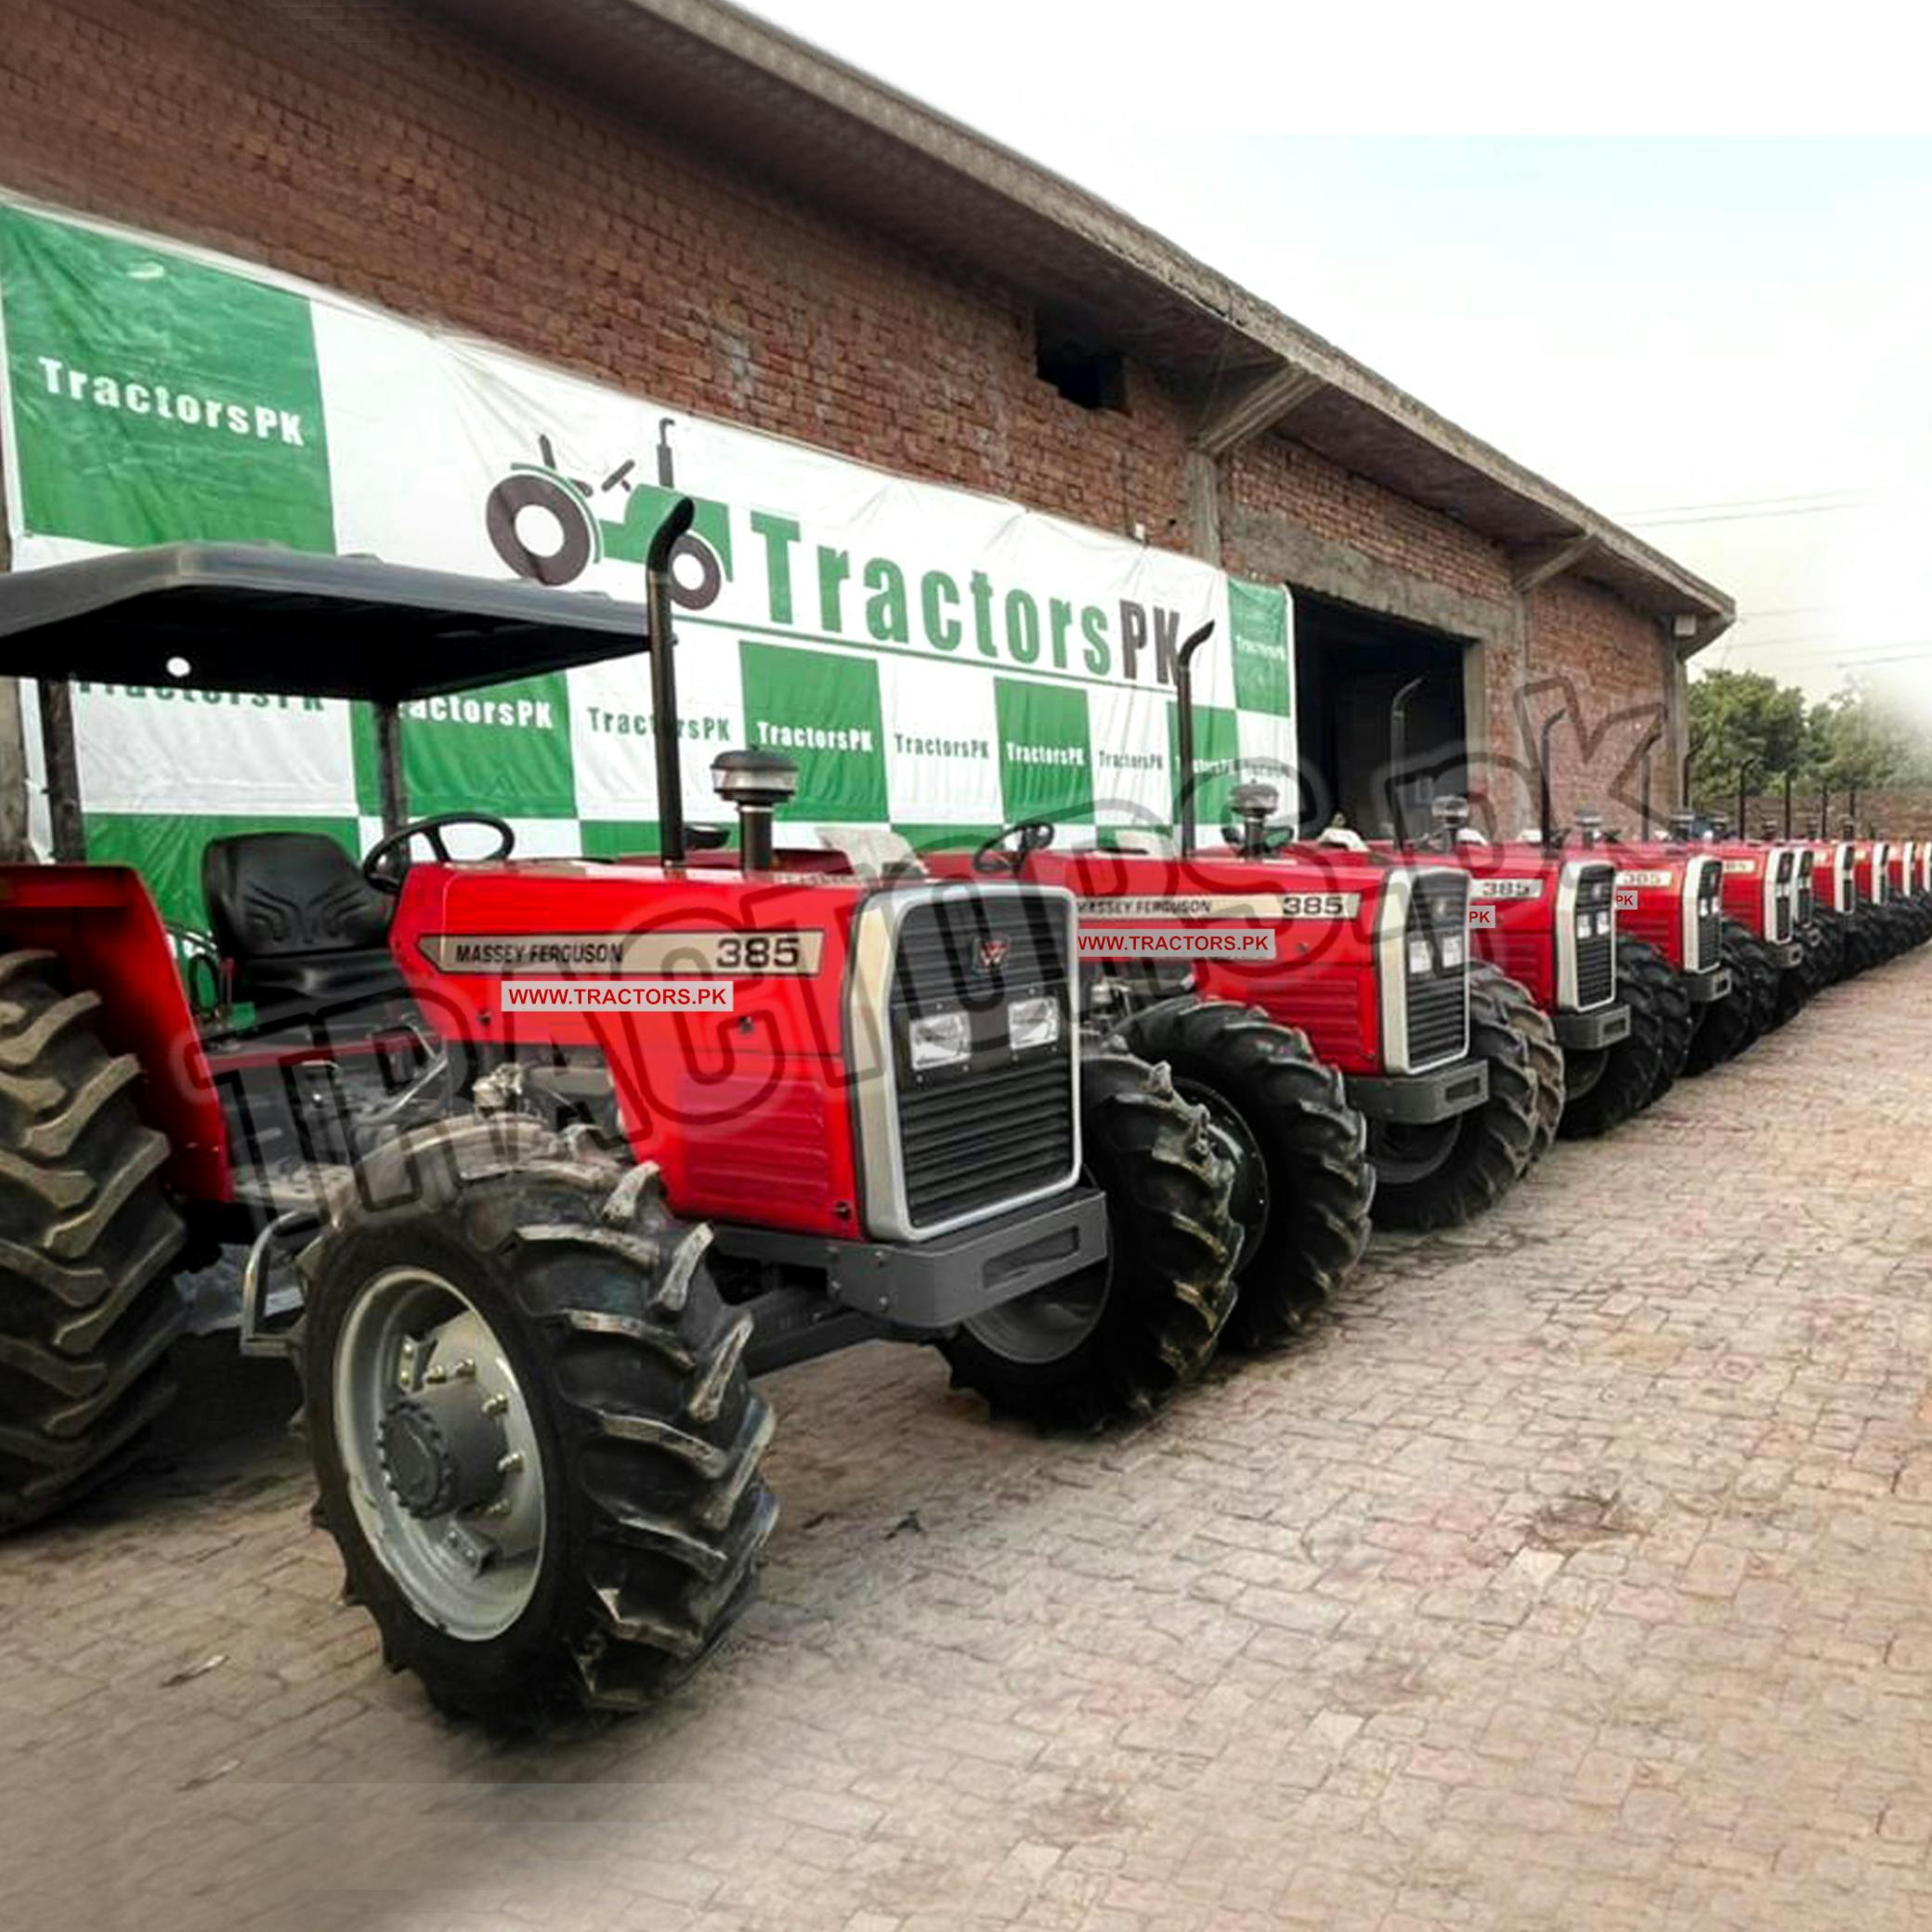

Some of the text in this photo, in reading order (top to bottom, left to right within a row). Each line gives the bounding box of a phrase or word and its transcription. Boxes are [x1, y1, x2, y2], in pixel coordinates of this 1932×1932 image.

[37, 355, 307, 447] TractorsPK
[750, 510, 1181, 687] TractorsPK
[398, 695, 553, 729] actorsPK
[586, 706, 730, 741] TracrsPK
[757, 722, 874, 751] TractorsPK
[894, 734, 990, 759] TractorsPK
[1006, 742, 1085, 766] TractorsPK
[1482, 881, 1531, 897] 385
[1283, 896, 1343, 915] 385
[455, 937, 800, 968] MASSEY FERGUSON 385
